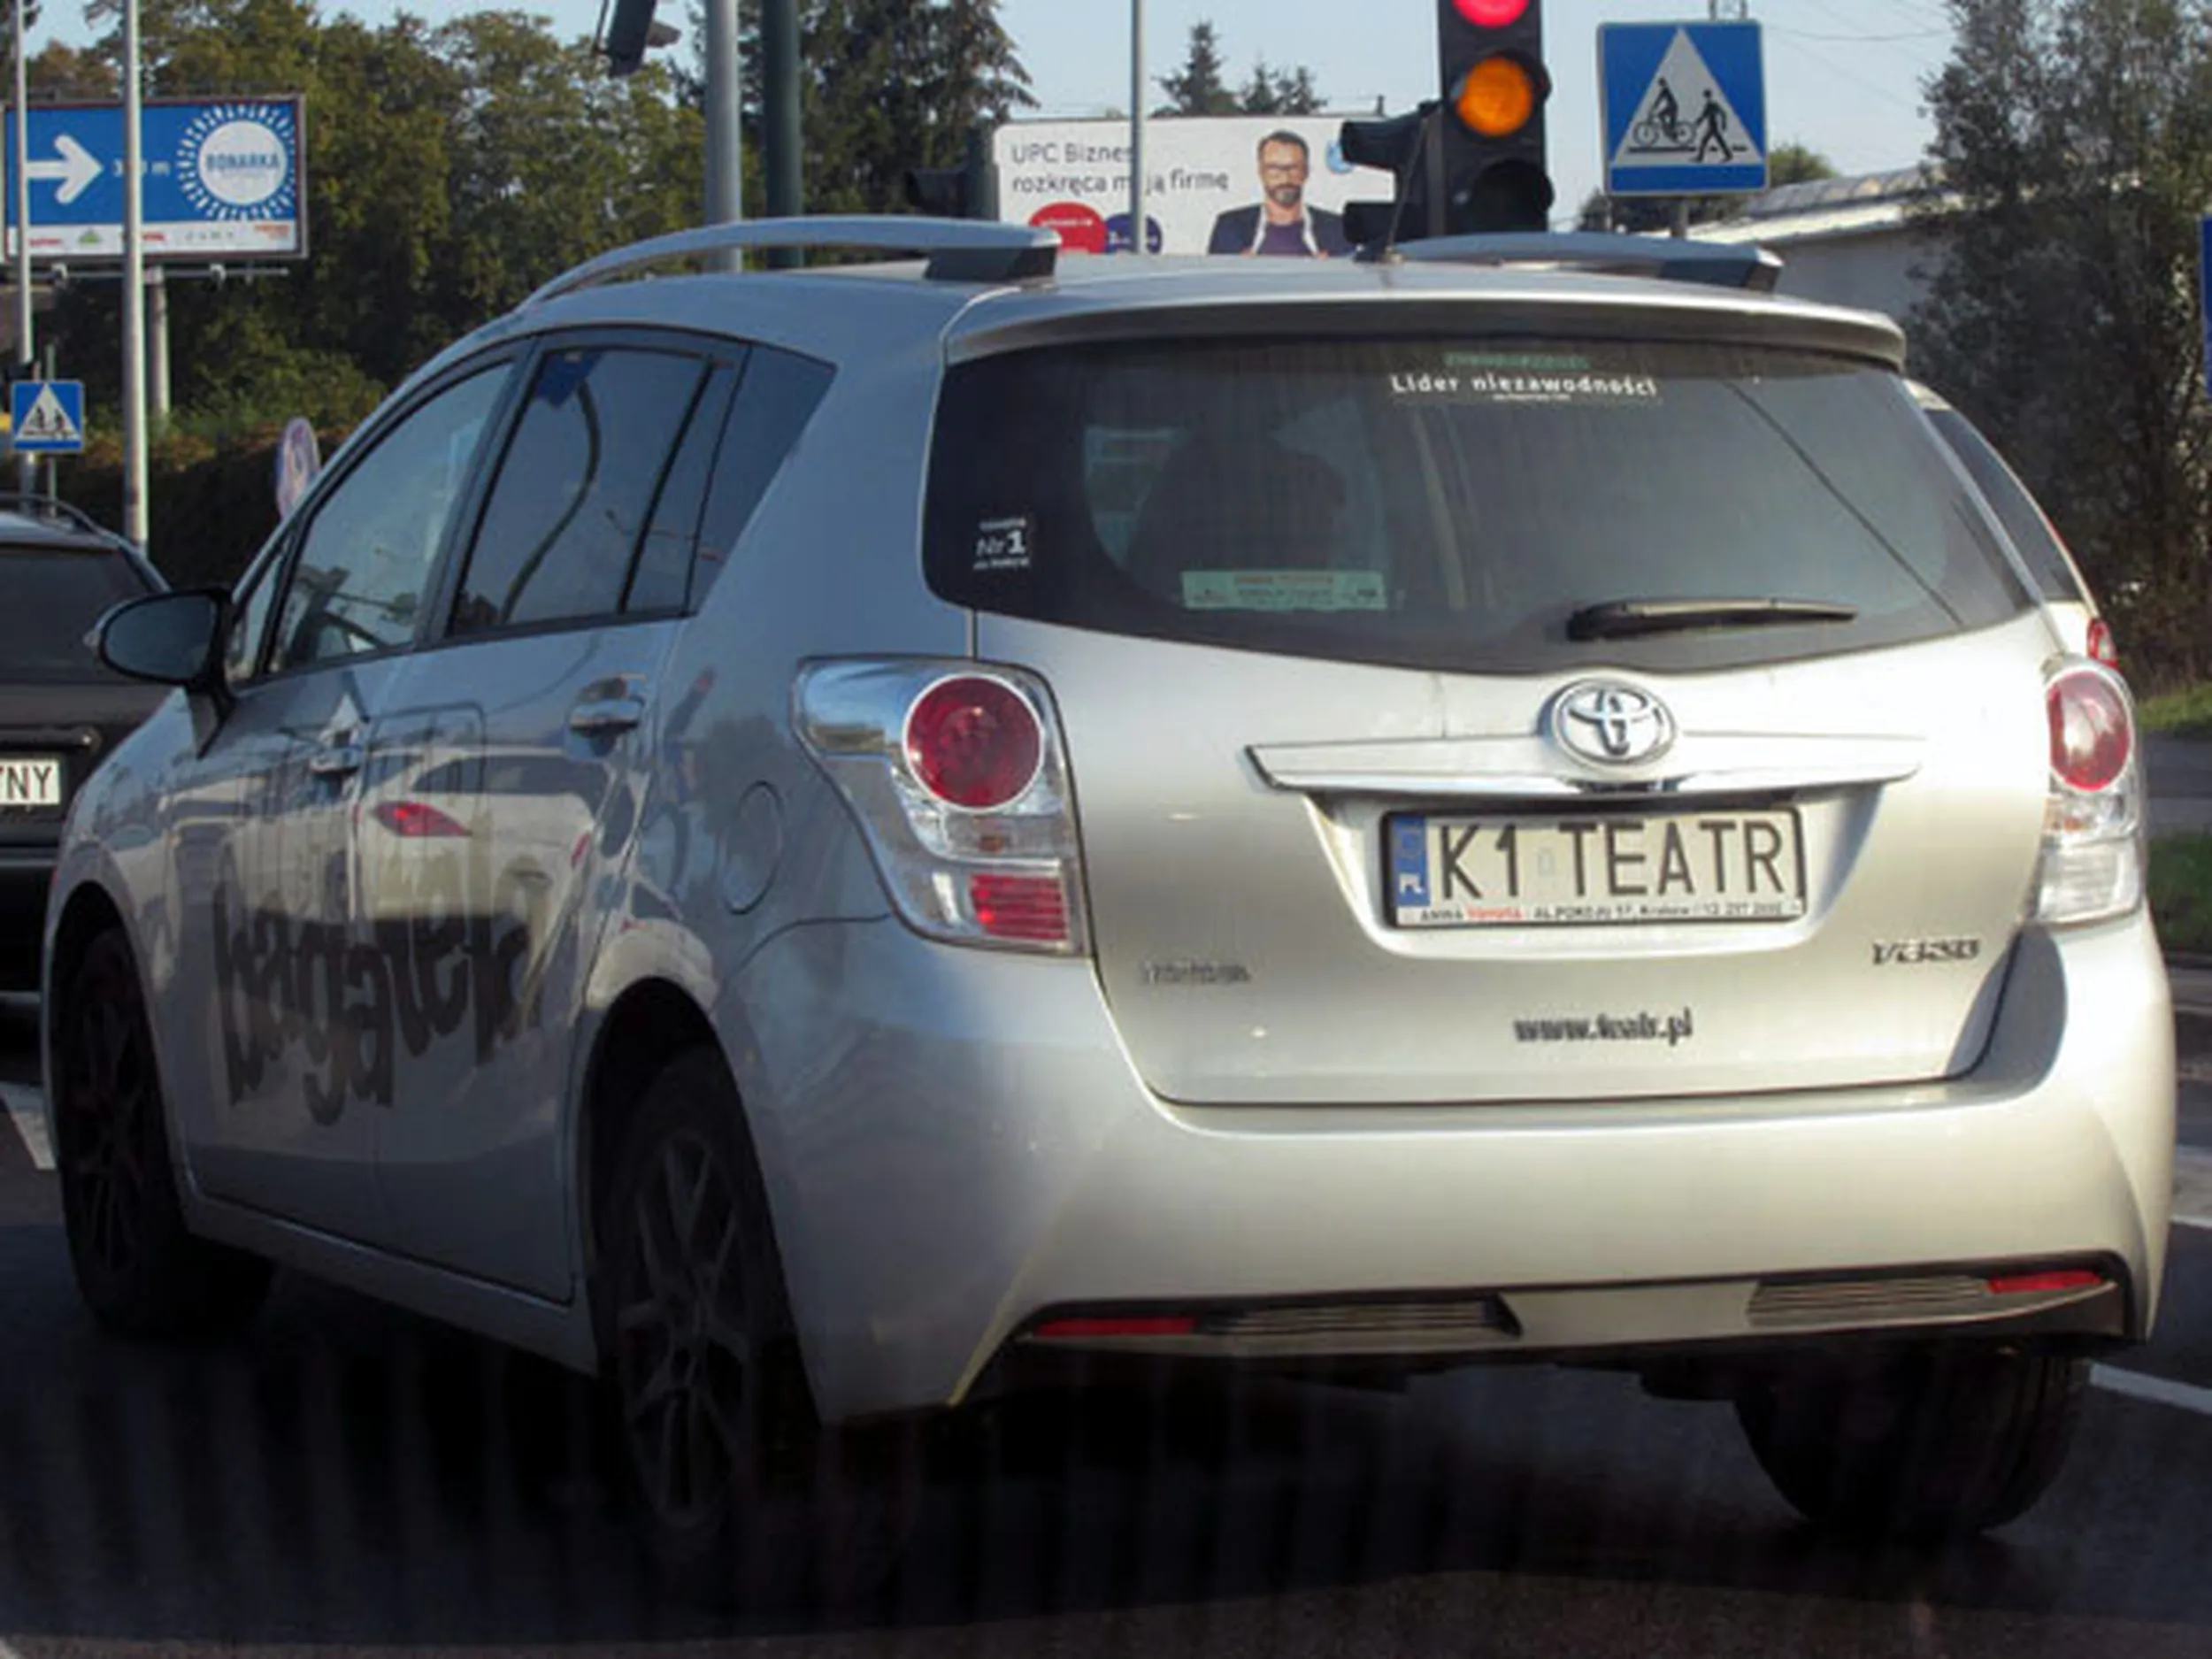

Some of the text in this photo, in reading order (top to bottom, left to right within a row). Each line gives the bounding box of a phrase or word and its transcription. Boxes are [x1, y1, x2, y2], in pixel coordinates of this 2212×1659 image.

[1011, 142, 1059, 164] UPC
[1112, 174, 1166, 196] mją
[0, 765, 52, 799] NY
[1440, 819, 1784, 901] K1 TEATR
